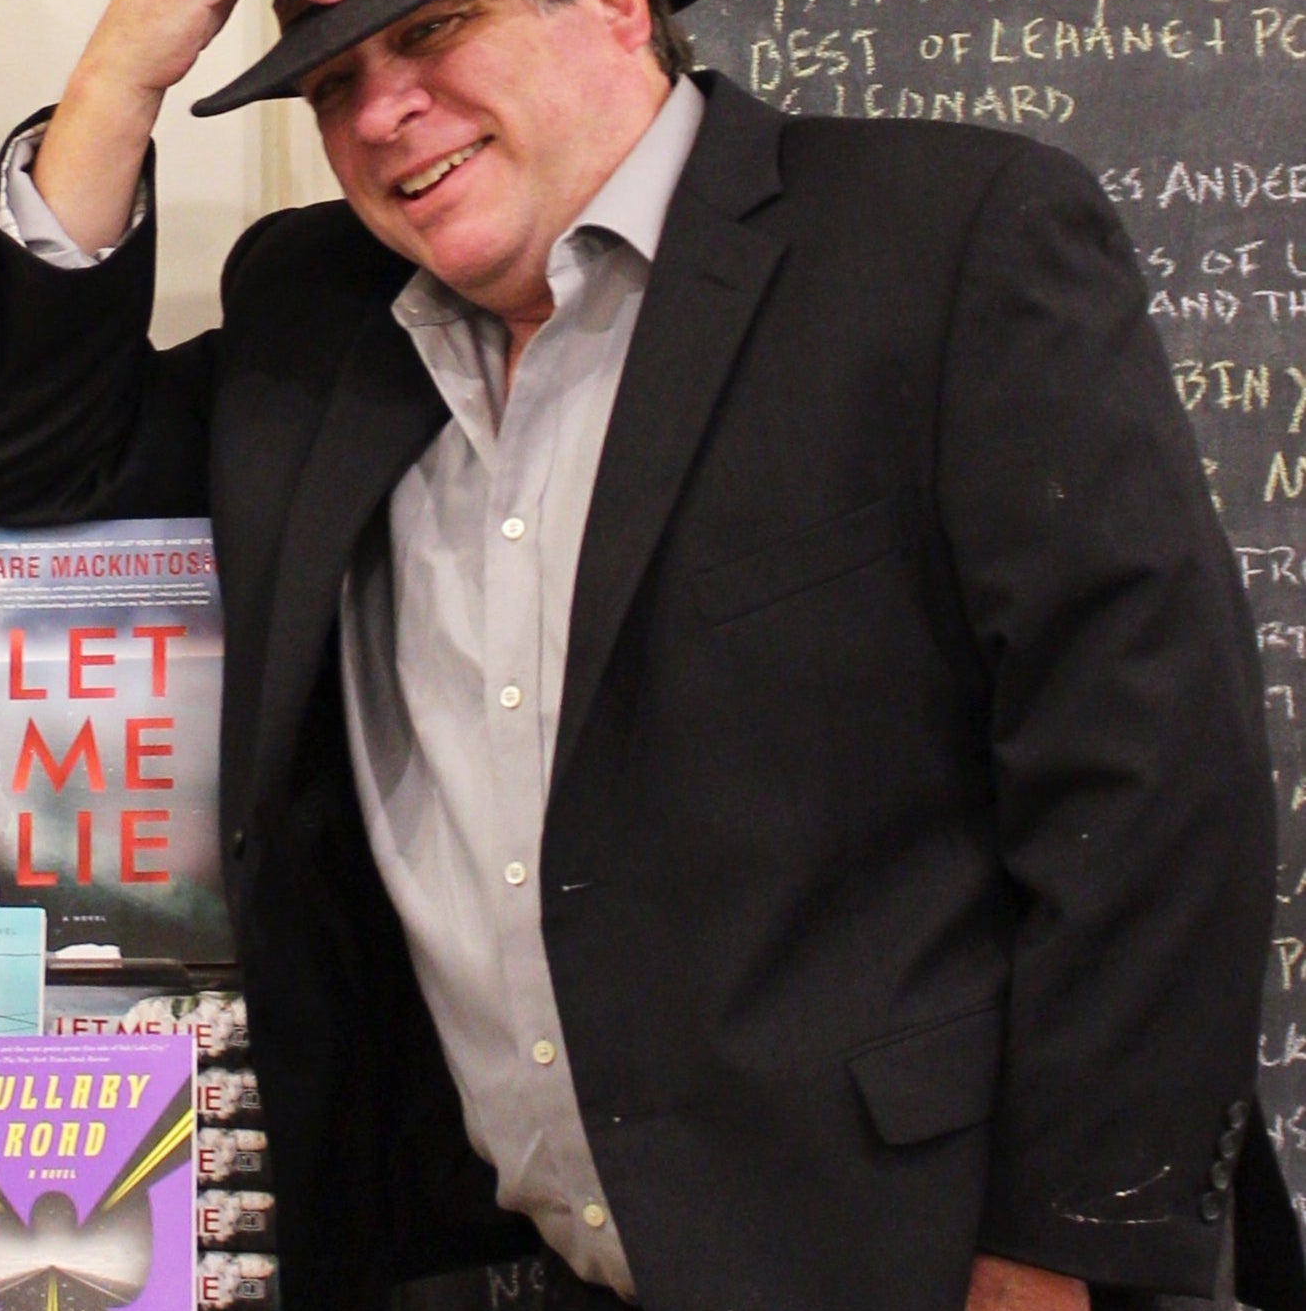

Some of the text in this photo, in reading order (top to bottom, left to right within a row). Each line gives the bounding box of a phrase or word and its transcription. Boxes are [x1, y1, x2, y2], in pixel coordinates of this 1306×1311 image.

[748, 26, 881, 91] BEST
[919, 29, 975, 64] OF
[1200, 240, 1266, 277] OF
[7, 625, 187, 701] LET
[11, 716, 175, 794] ME
[15, 809, 171, 887] LIE
[2, 1122, 108, 1158] ROAD
[39, 1169, 77, 1180] NOVEL
